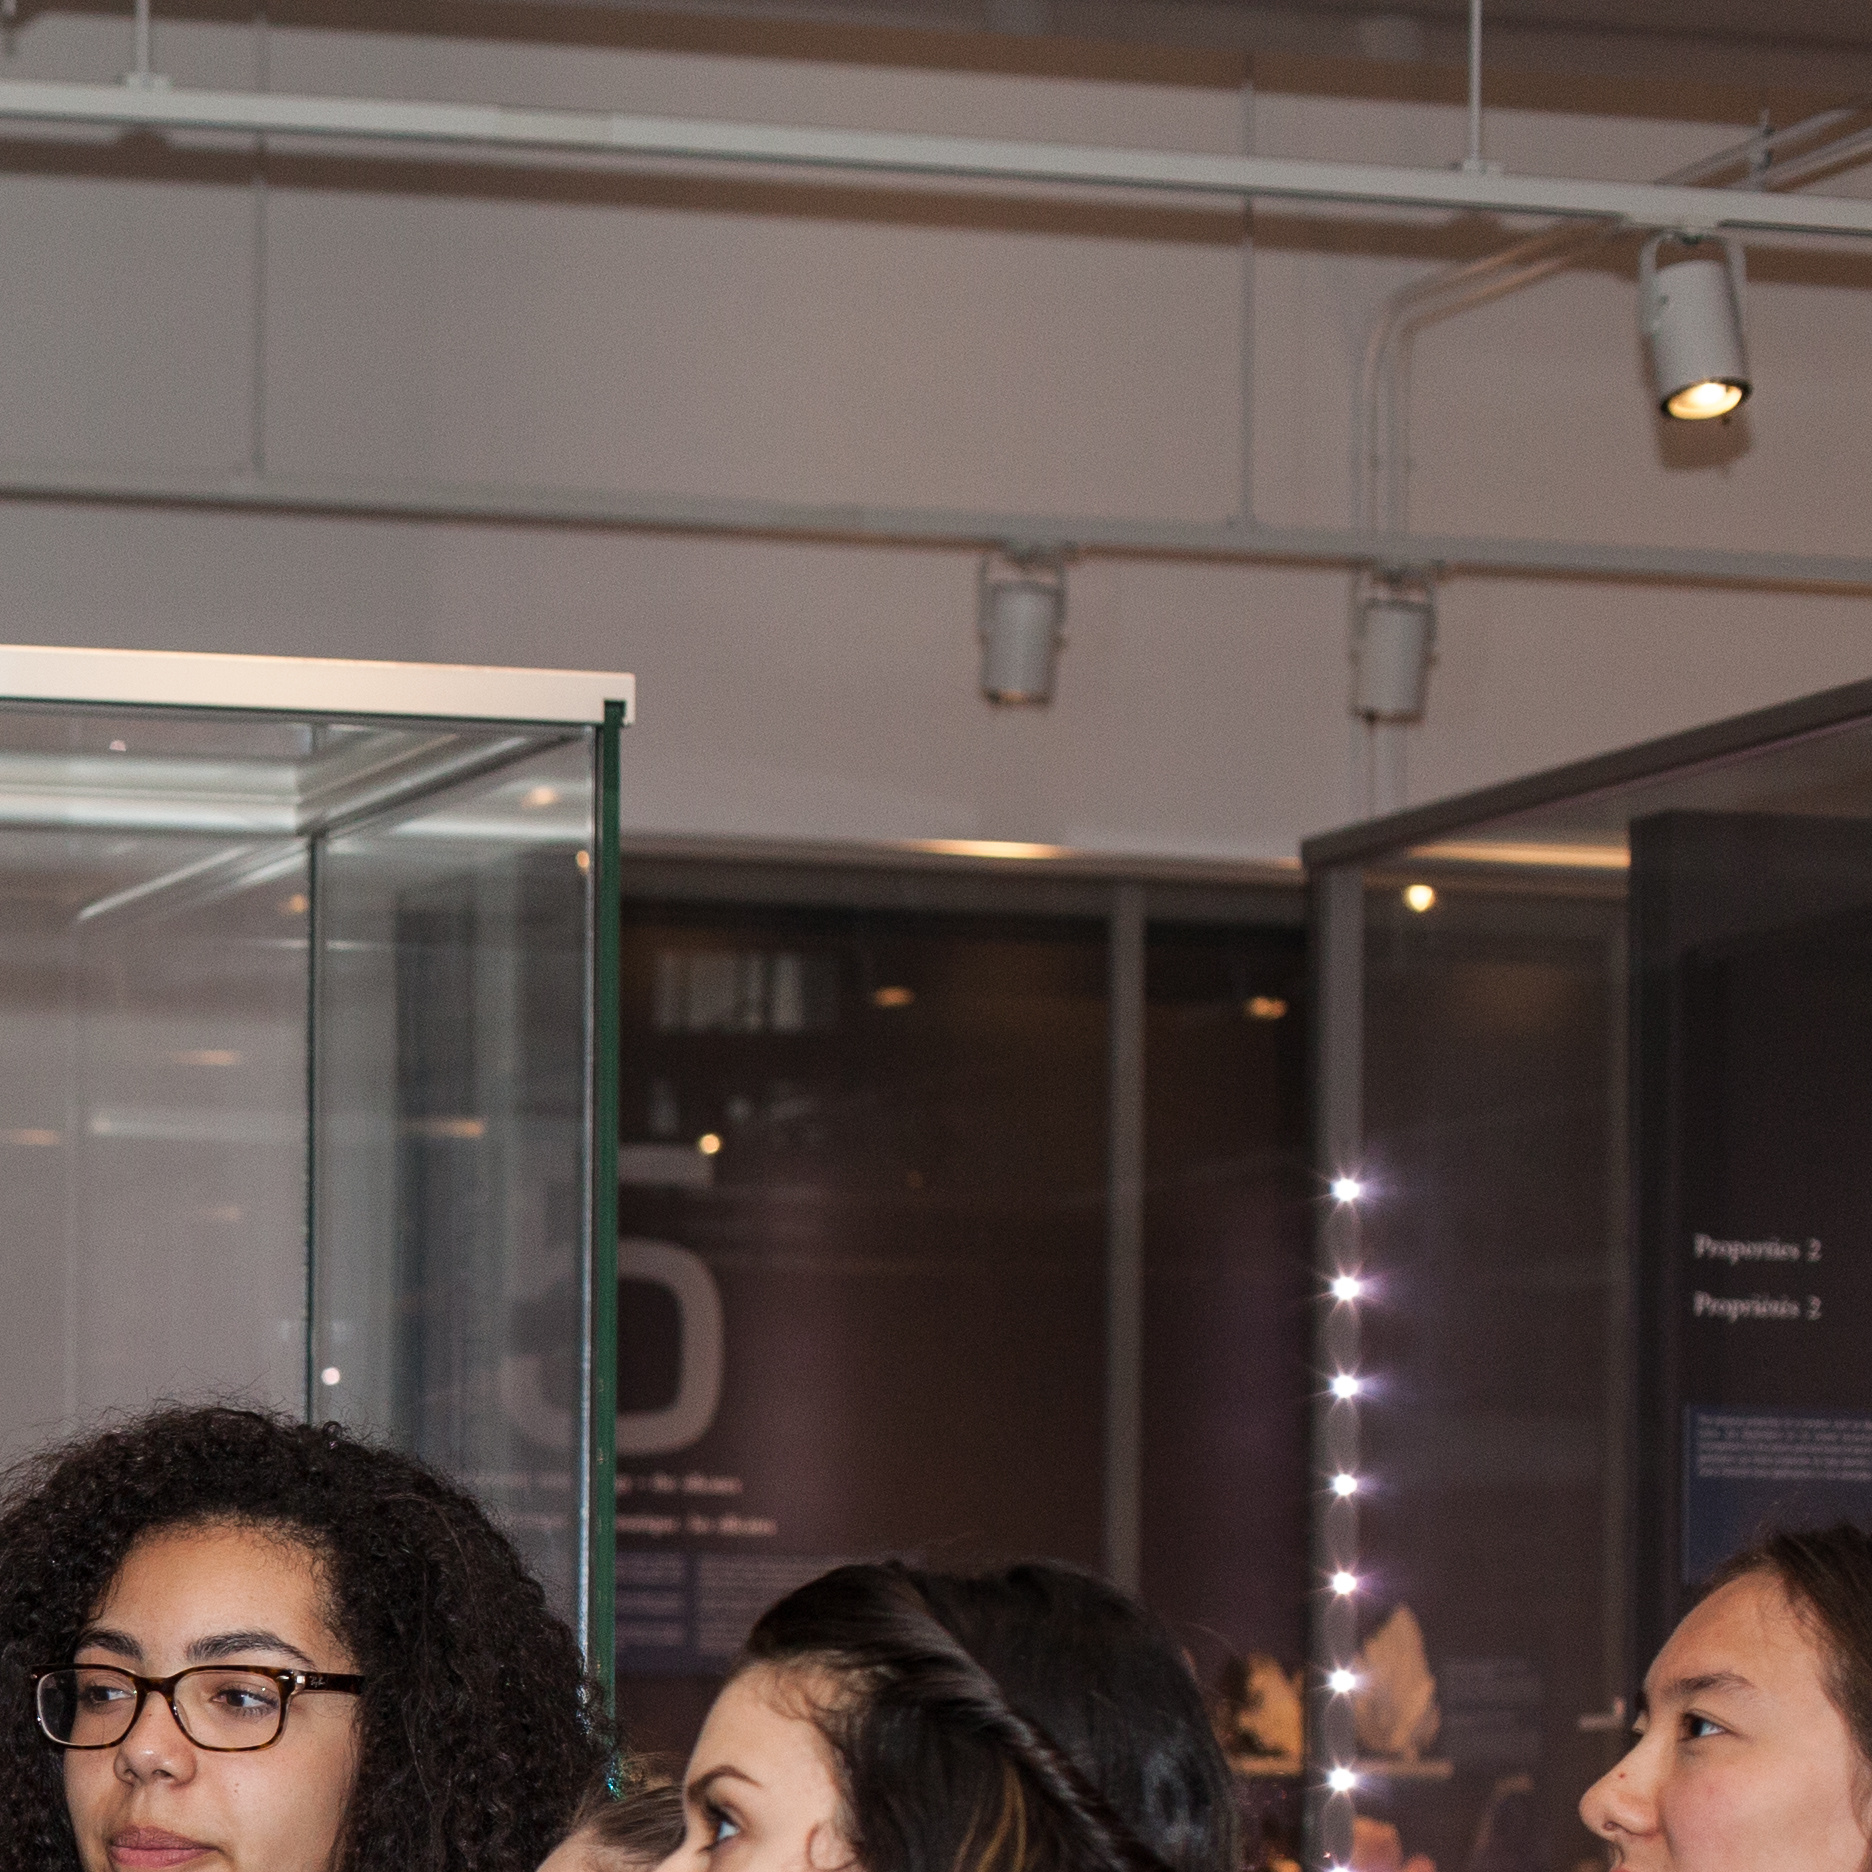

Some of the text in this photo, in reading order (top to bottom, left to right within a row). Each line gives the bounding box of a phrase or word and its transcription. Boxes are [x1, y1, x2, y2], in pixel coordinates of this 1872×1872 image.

[1694, 1233, 1822, 1265] Properties 2
[1807, 1295, 1822, 1320] 2
